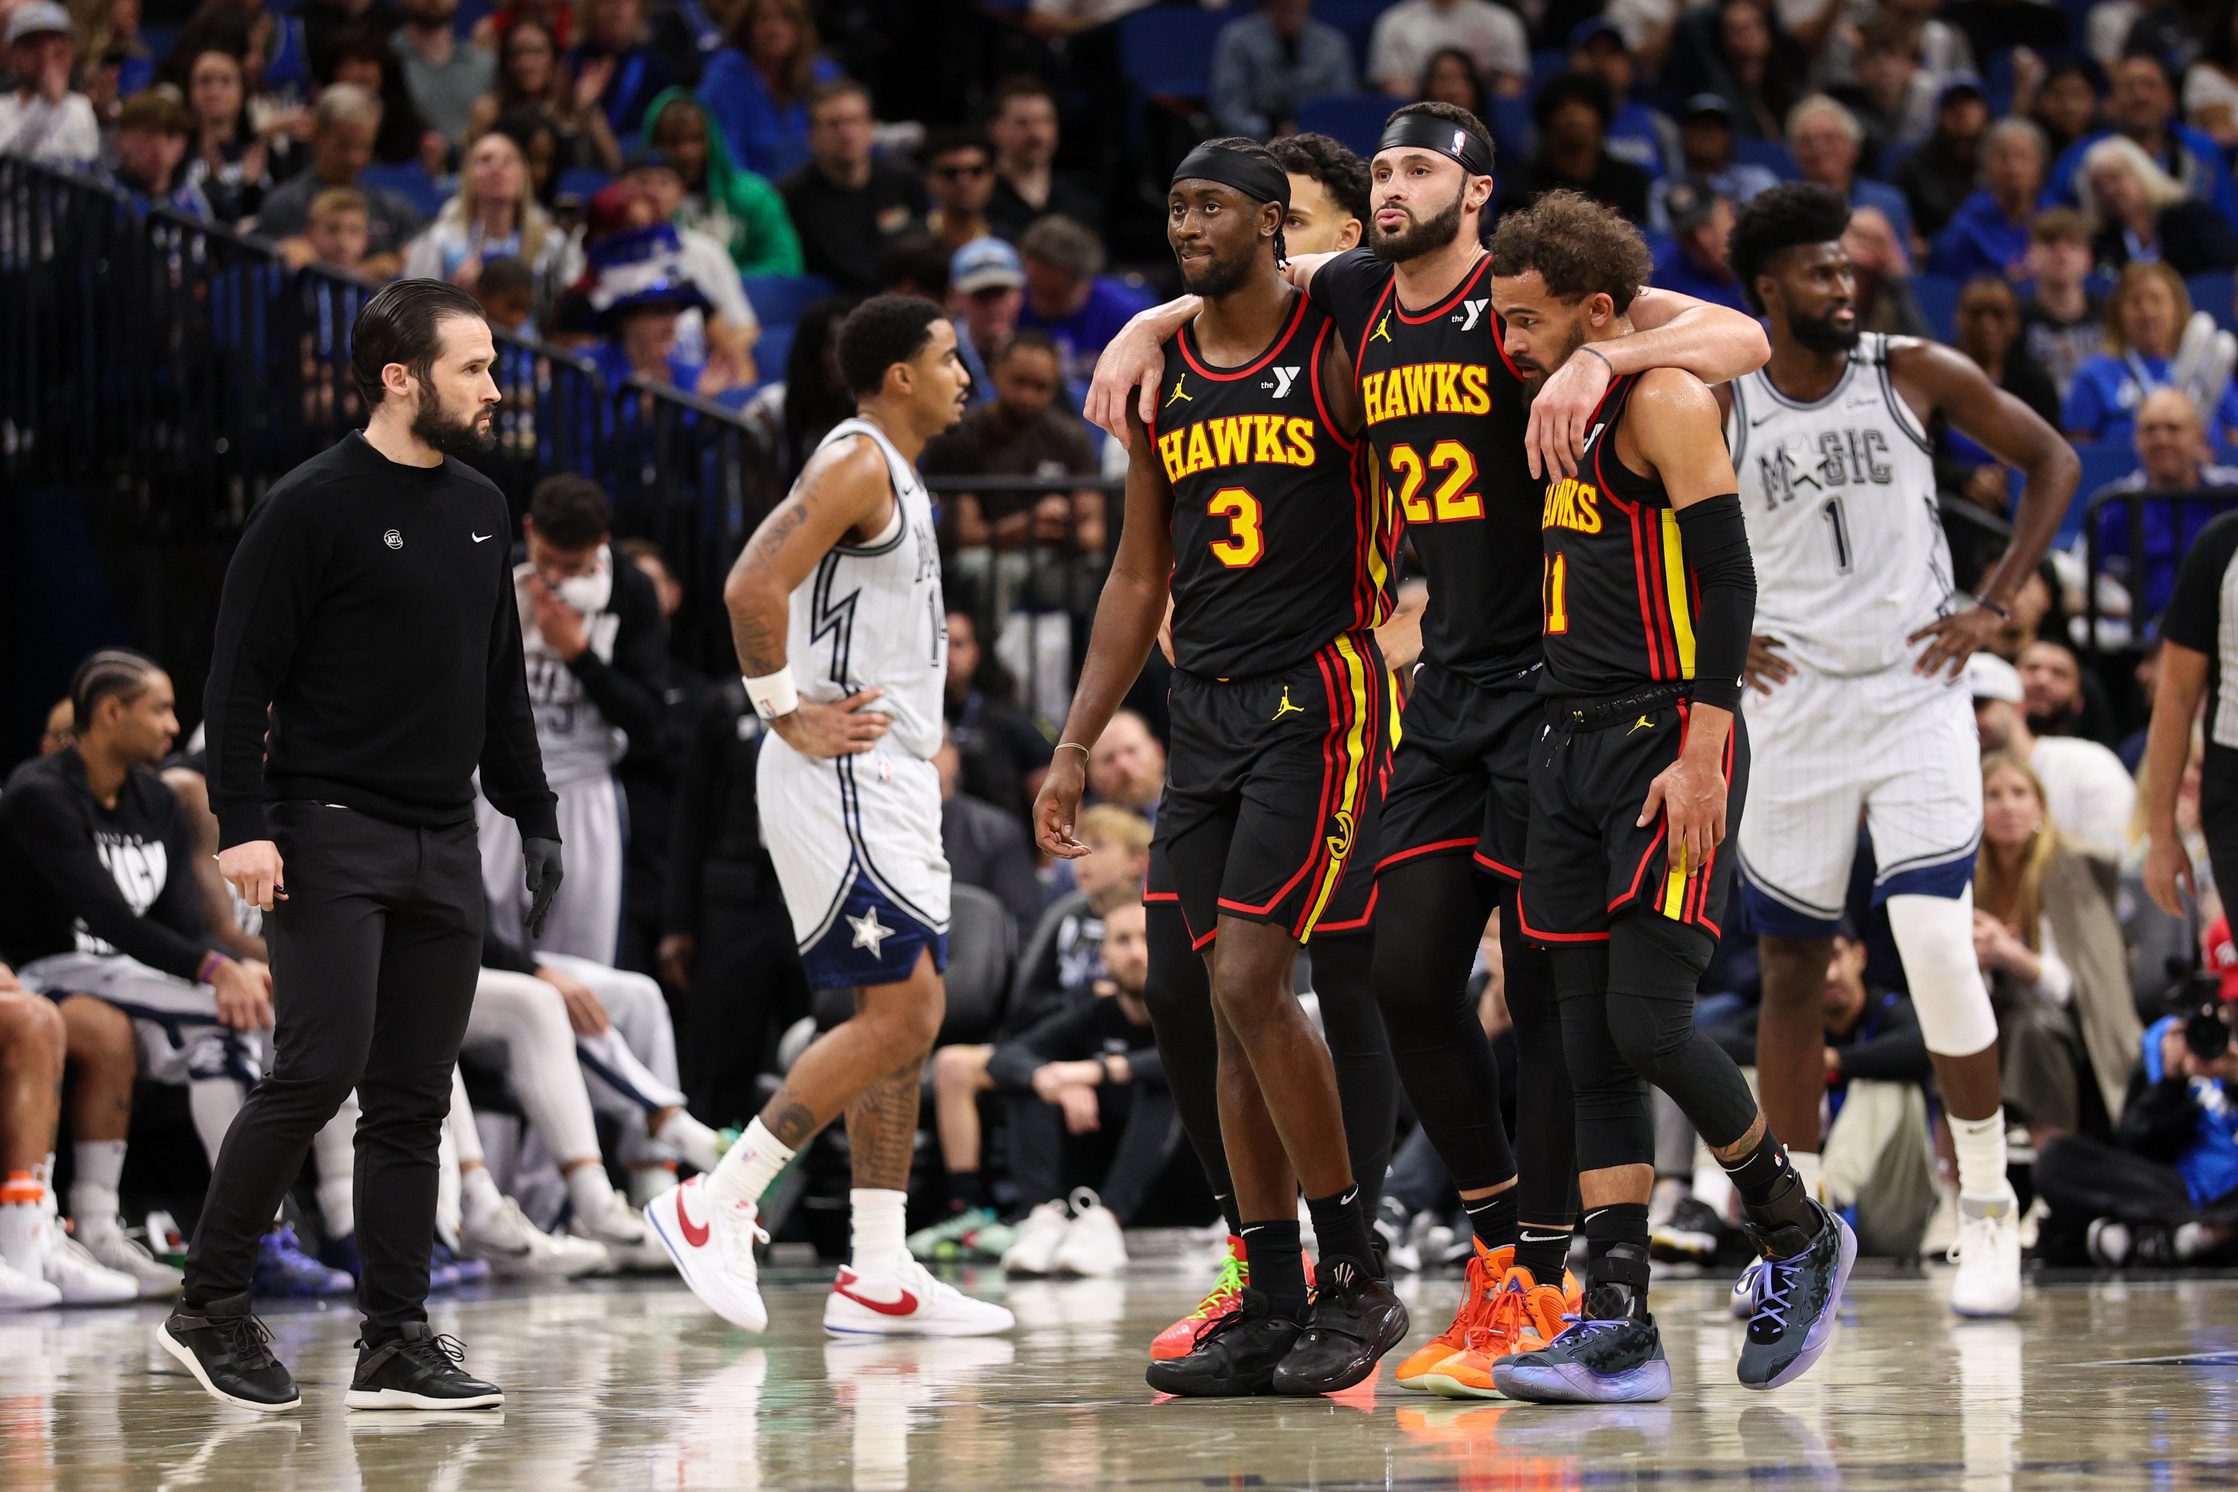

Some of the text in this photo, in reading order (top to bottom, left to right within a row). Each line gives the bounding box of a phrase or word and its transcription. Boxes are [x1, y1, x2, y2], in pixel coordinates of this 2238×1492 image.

[1451, 315, 1464, 323] the
[1260, 381, 1274, 389] the
[1362, 362, 1492, 427] HAWKS
[1157, 413, 1316, 485] HAWKS
[1388, 439, 1486, 524] 22
[1207, 487, 1265, 568] 3
[1541, 476, 1604, 535] AWKS
[1819, 496, 1854, 576] 1
[928, 584, 949, 668] 1
[1542, 551, 1568, 635] 1
